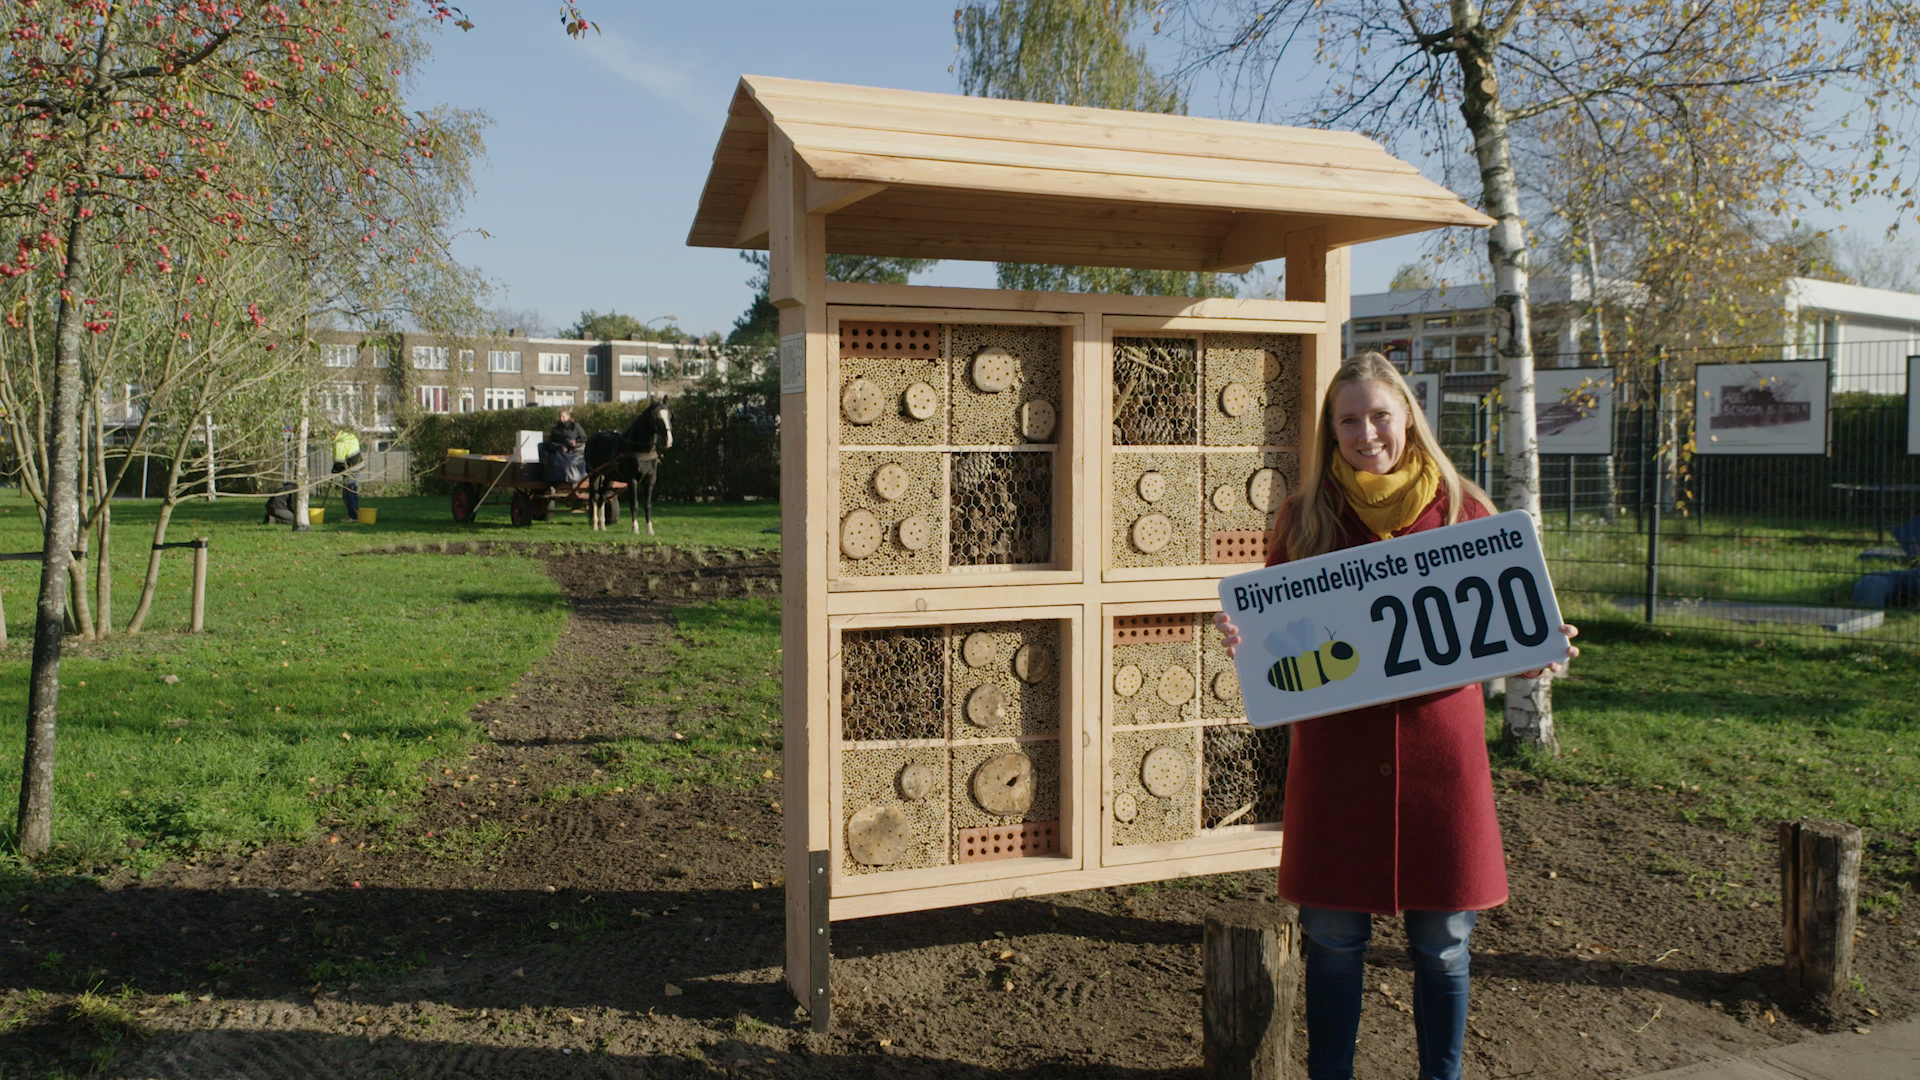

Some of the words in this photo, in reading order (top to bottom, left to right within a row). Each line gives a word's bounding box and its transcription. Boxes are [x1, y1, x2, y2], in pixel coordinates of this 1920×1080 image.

[1234, 554, 1408, 614] Bijvriendelijkste
[1414, 528, 1524, 577] gemeente
[1370, 566, 1549, 678] 2020
